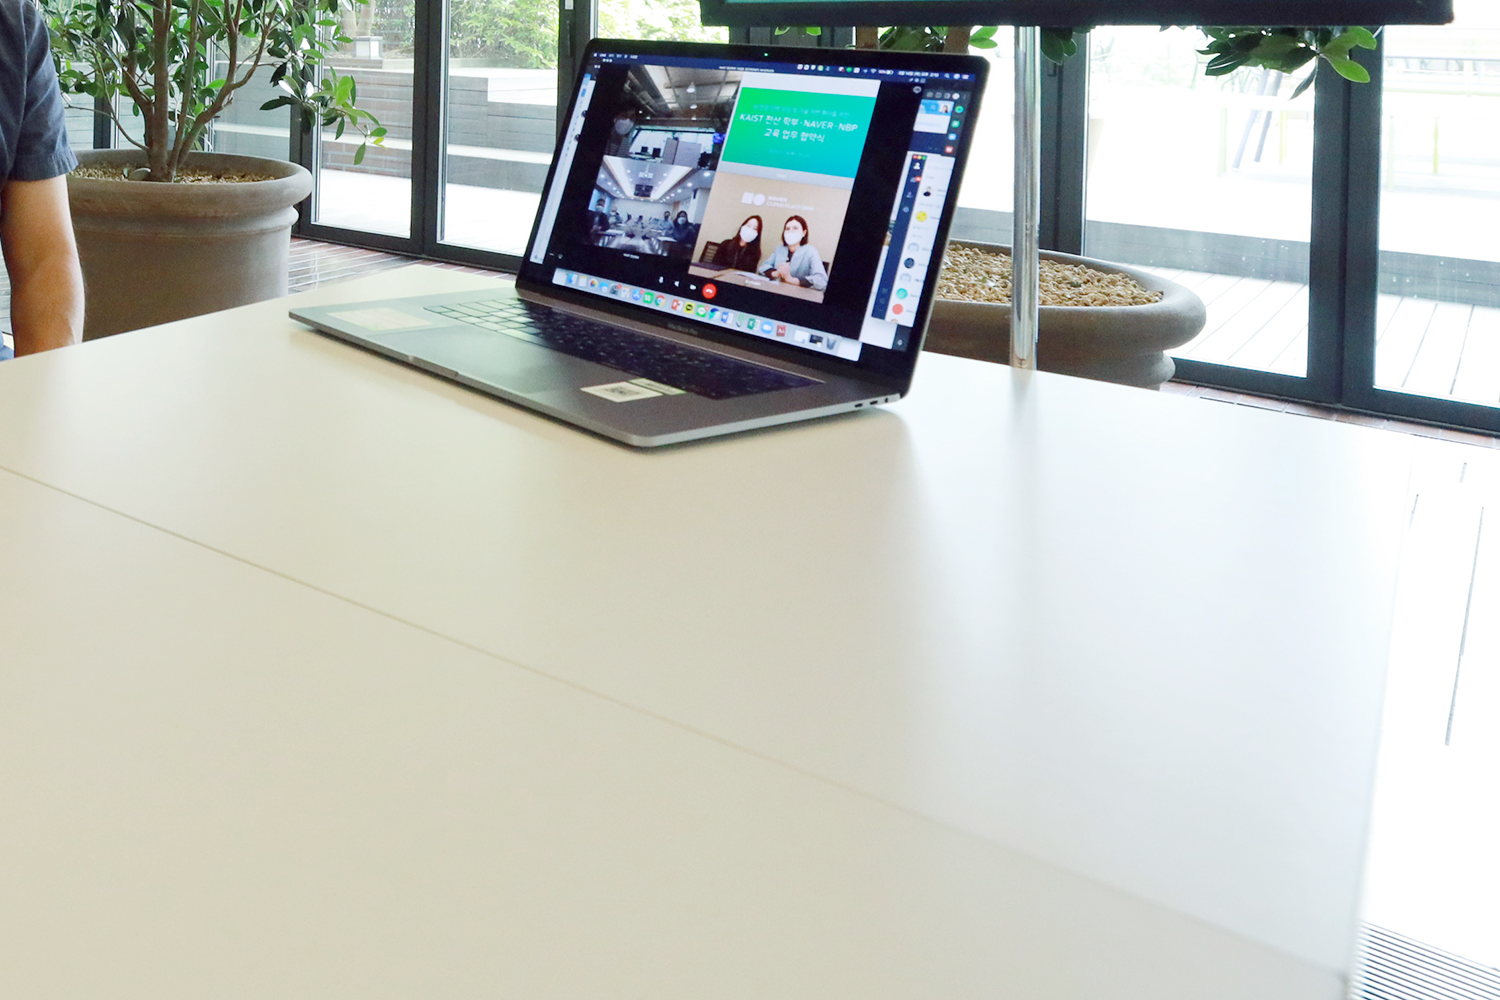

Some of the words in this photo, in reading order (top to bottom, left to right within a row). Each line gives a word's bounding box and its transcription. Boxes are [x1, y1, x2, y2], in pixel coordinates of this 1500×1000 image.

[740, 113, 764, 122] KAIST
[765, 115, 781, 126] 전산
[783, 116, 799, 127] 학부
[803, 119, 834, 129] NAVER
[838, 122, 858, 132] NBP
[764, 128, 780, 138] 교육
[782, 130, 798, 140] 업무
